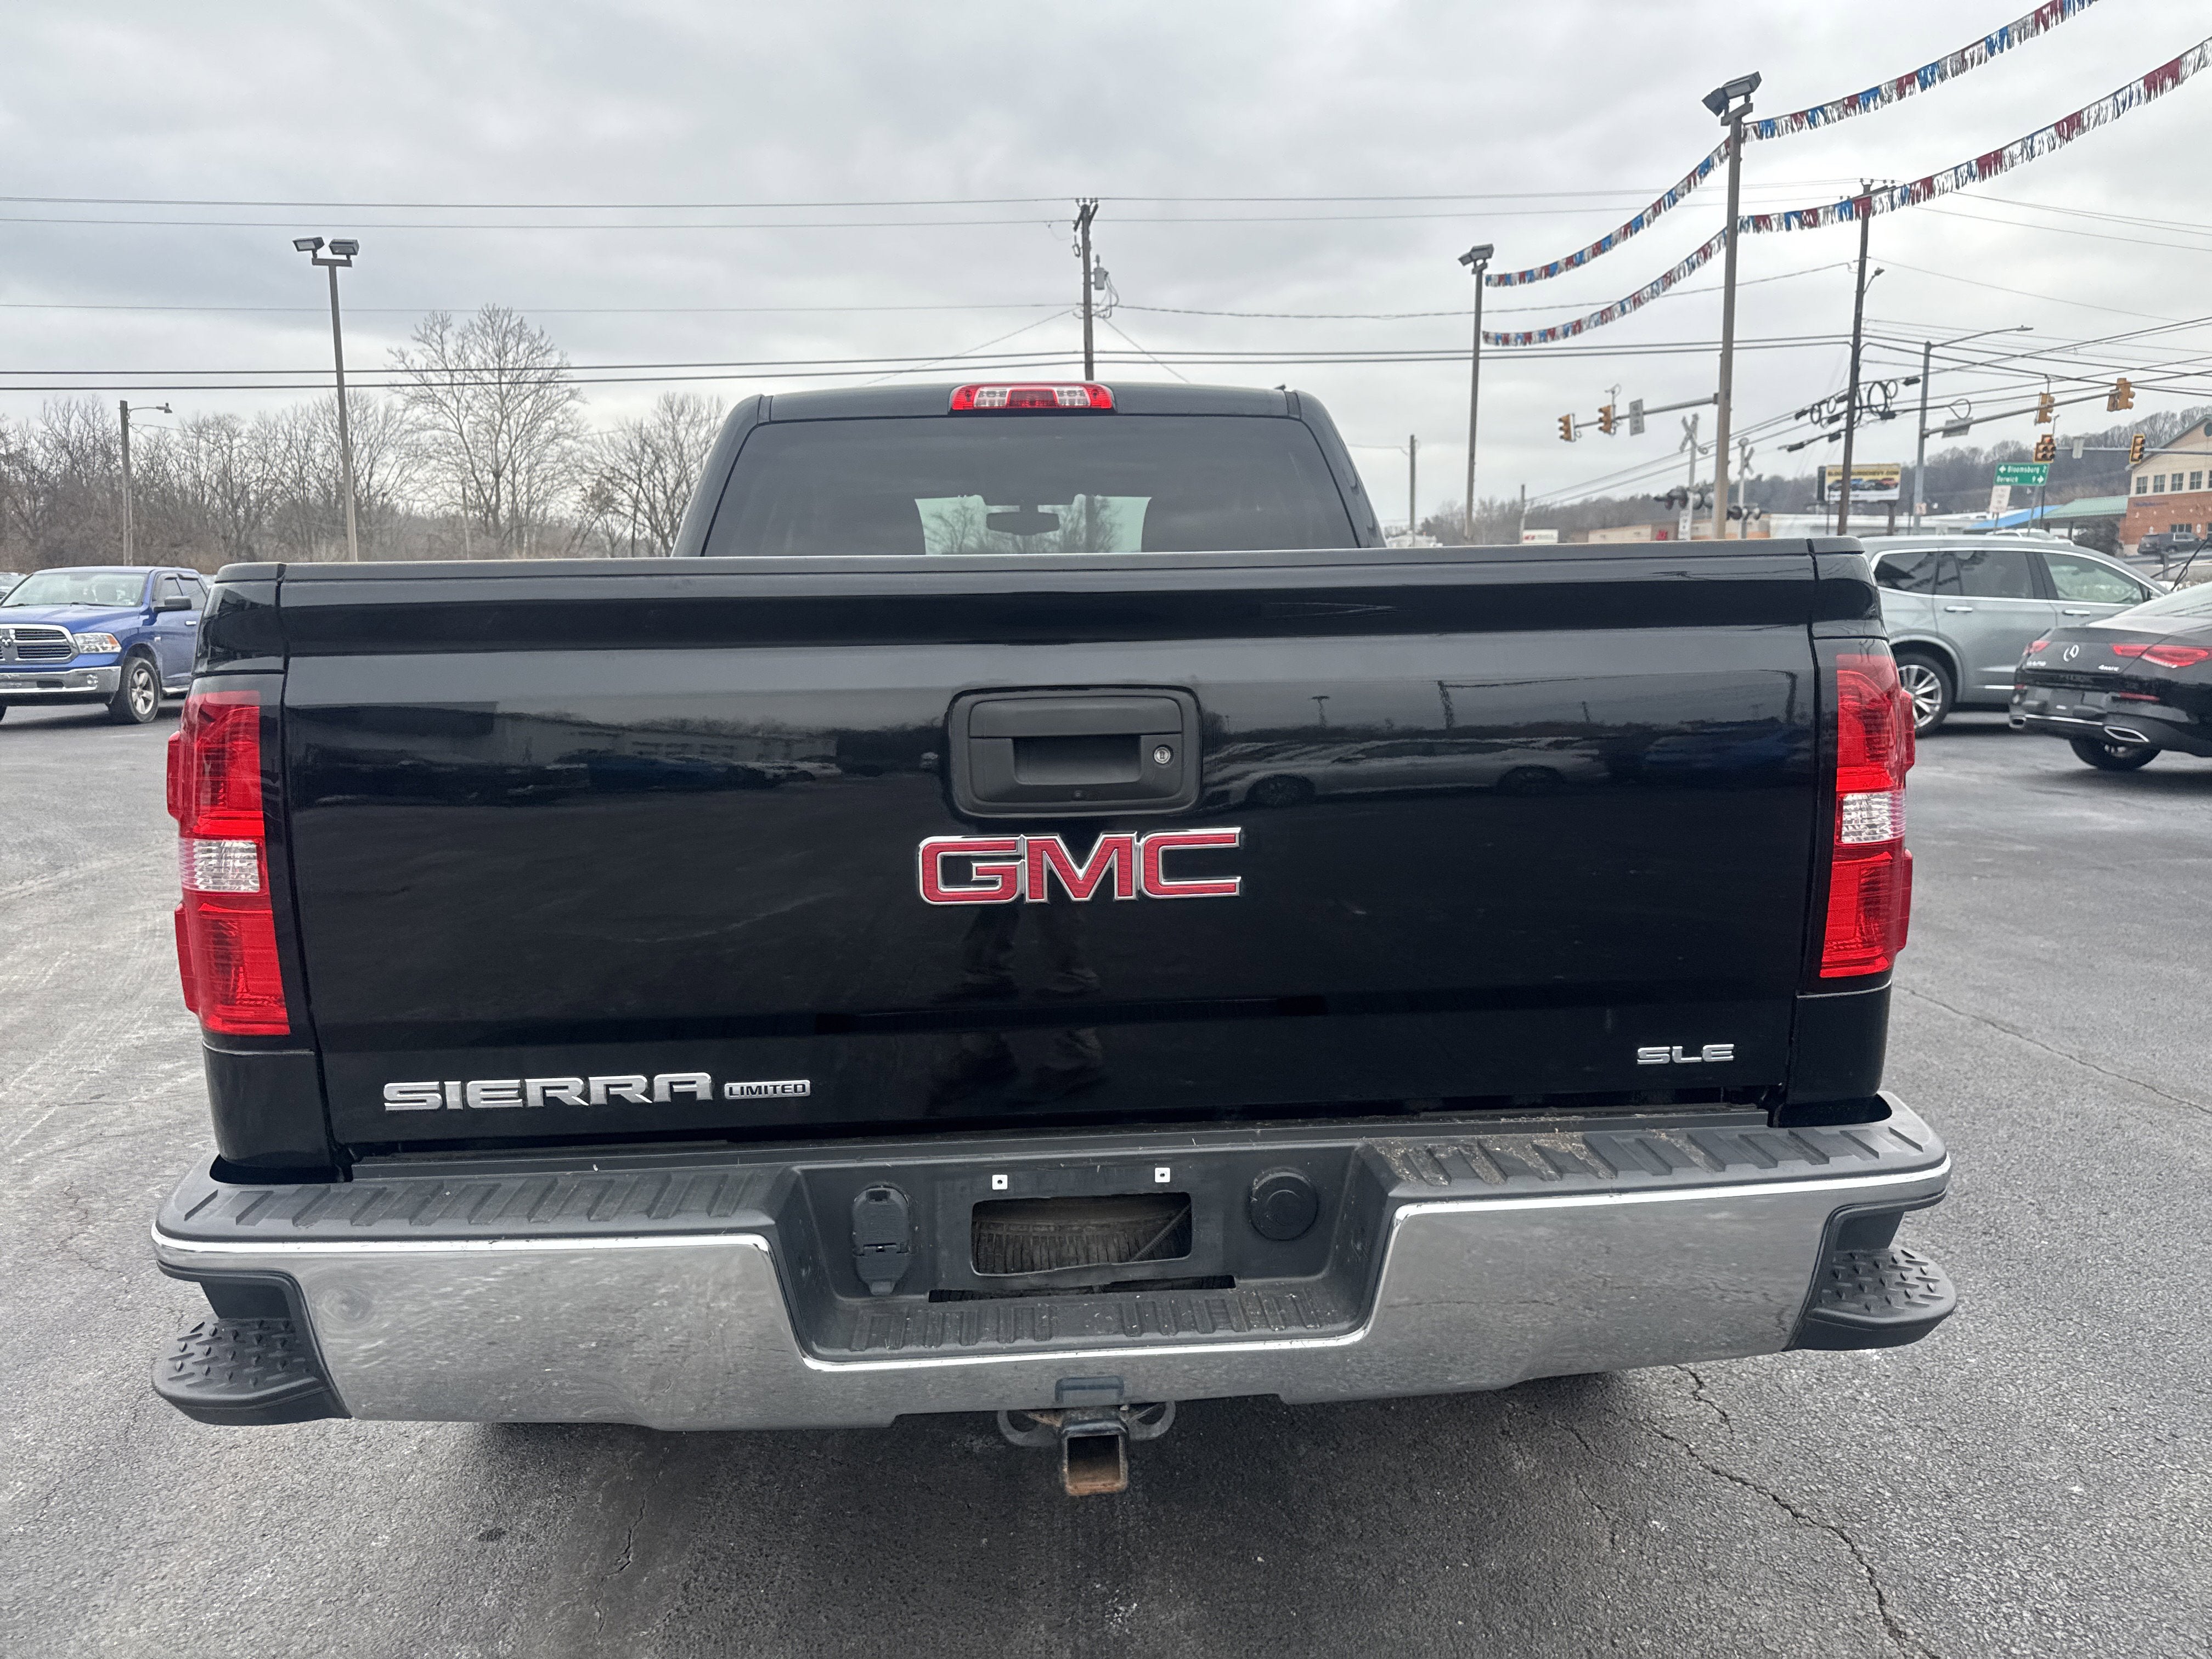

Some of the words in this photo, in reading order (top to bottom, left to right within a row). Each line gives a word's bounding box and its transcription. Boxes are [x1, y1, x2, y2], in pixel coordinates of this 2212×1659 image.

[2007, 466, 2040, 475] Bloomsburg
[918, 826, 1242, 905] GMC
[1637, 1043, 1735, 1065] SLE
[383, 1072, 713, 1111] SIERRA
[727, 1083, 808, 1098] LIMITED
